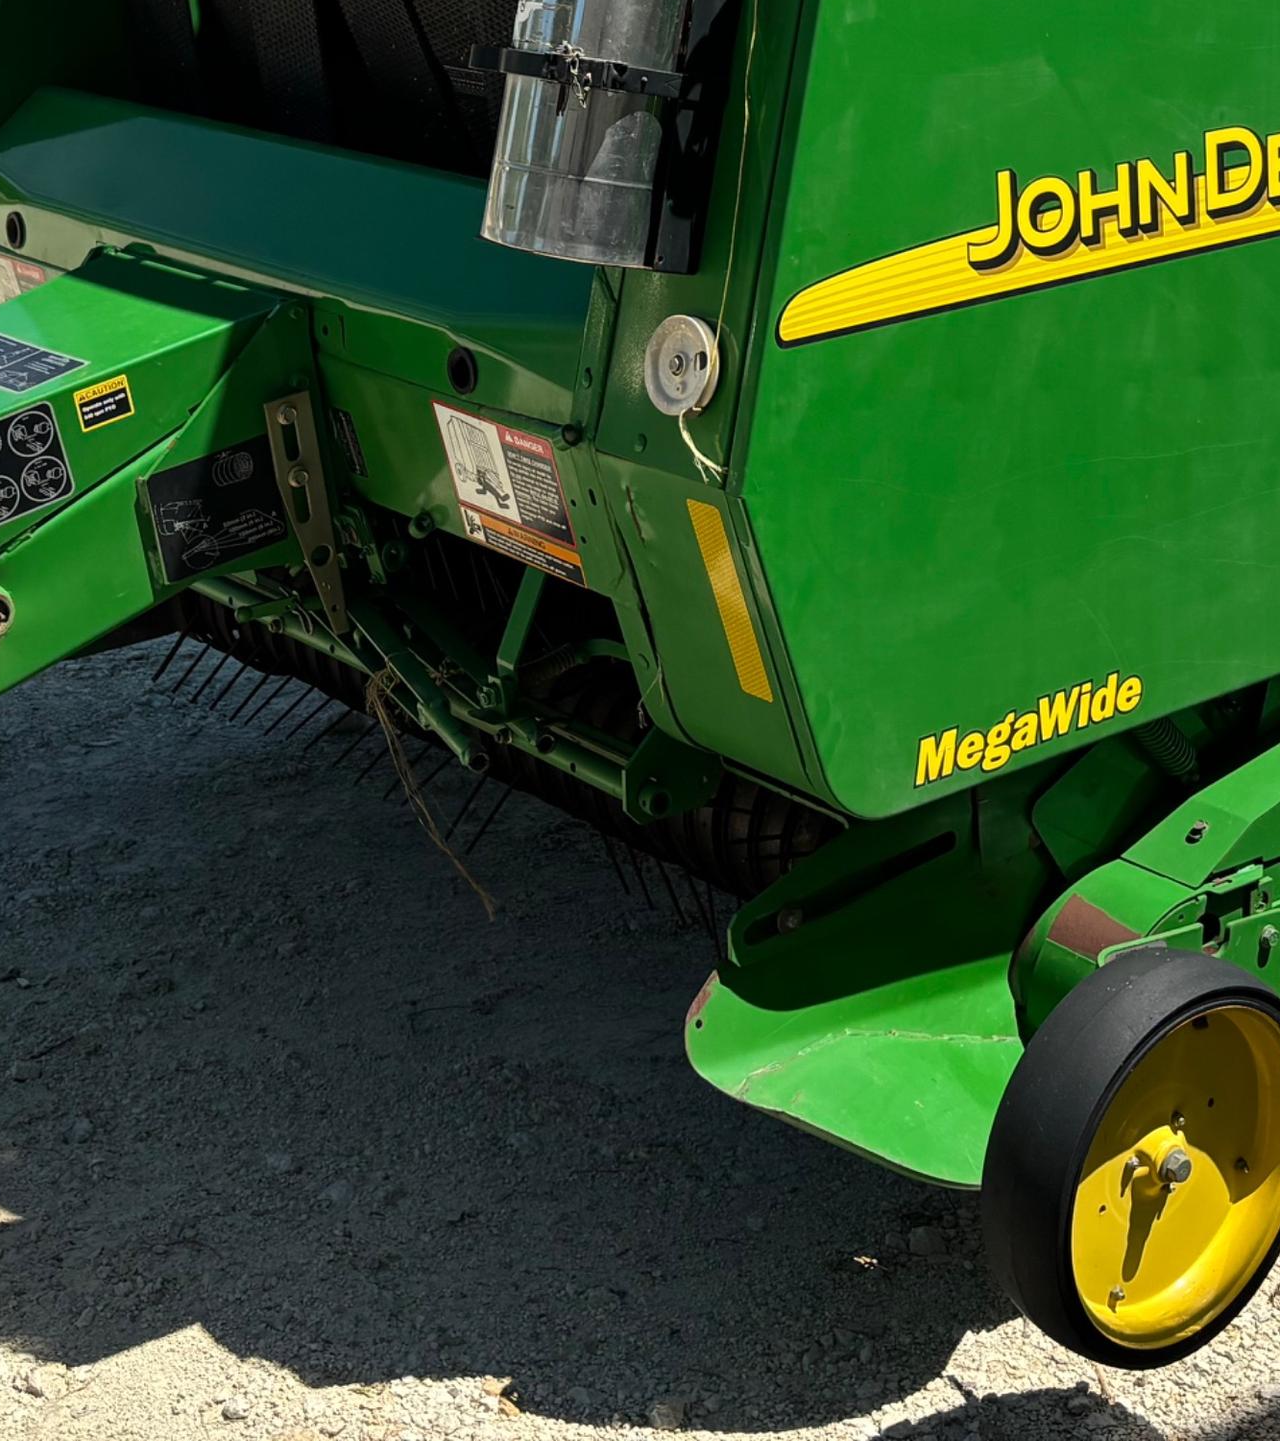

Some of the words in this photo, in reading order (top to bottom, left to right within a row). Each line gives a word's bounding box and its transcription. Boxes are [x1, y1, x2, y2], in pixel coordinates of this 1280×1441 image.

[966, 150, 1202, 272] JOHN
[85, 379, 124, 400] CAUTION
[513, 436, 545, 455] DANGER
[913, 670, 1144, 789] MegaWide
